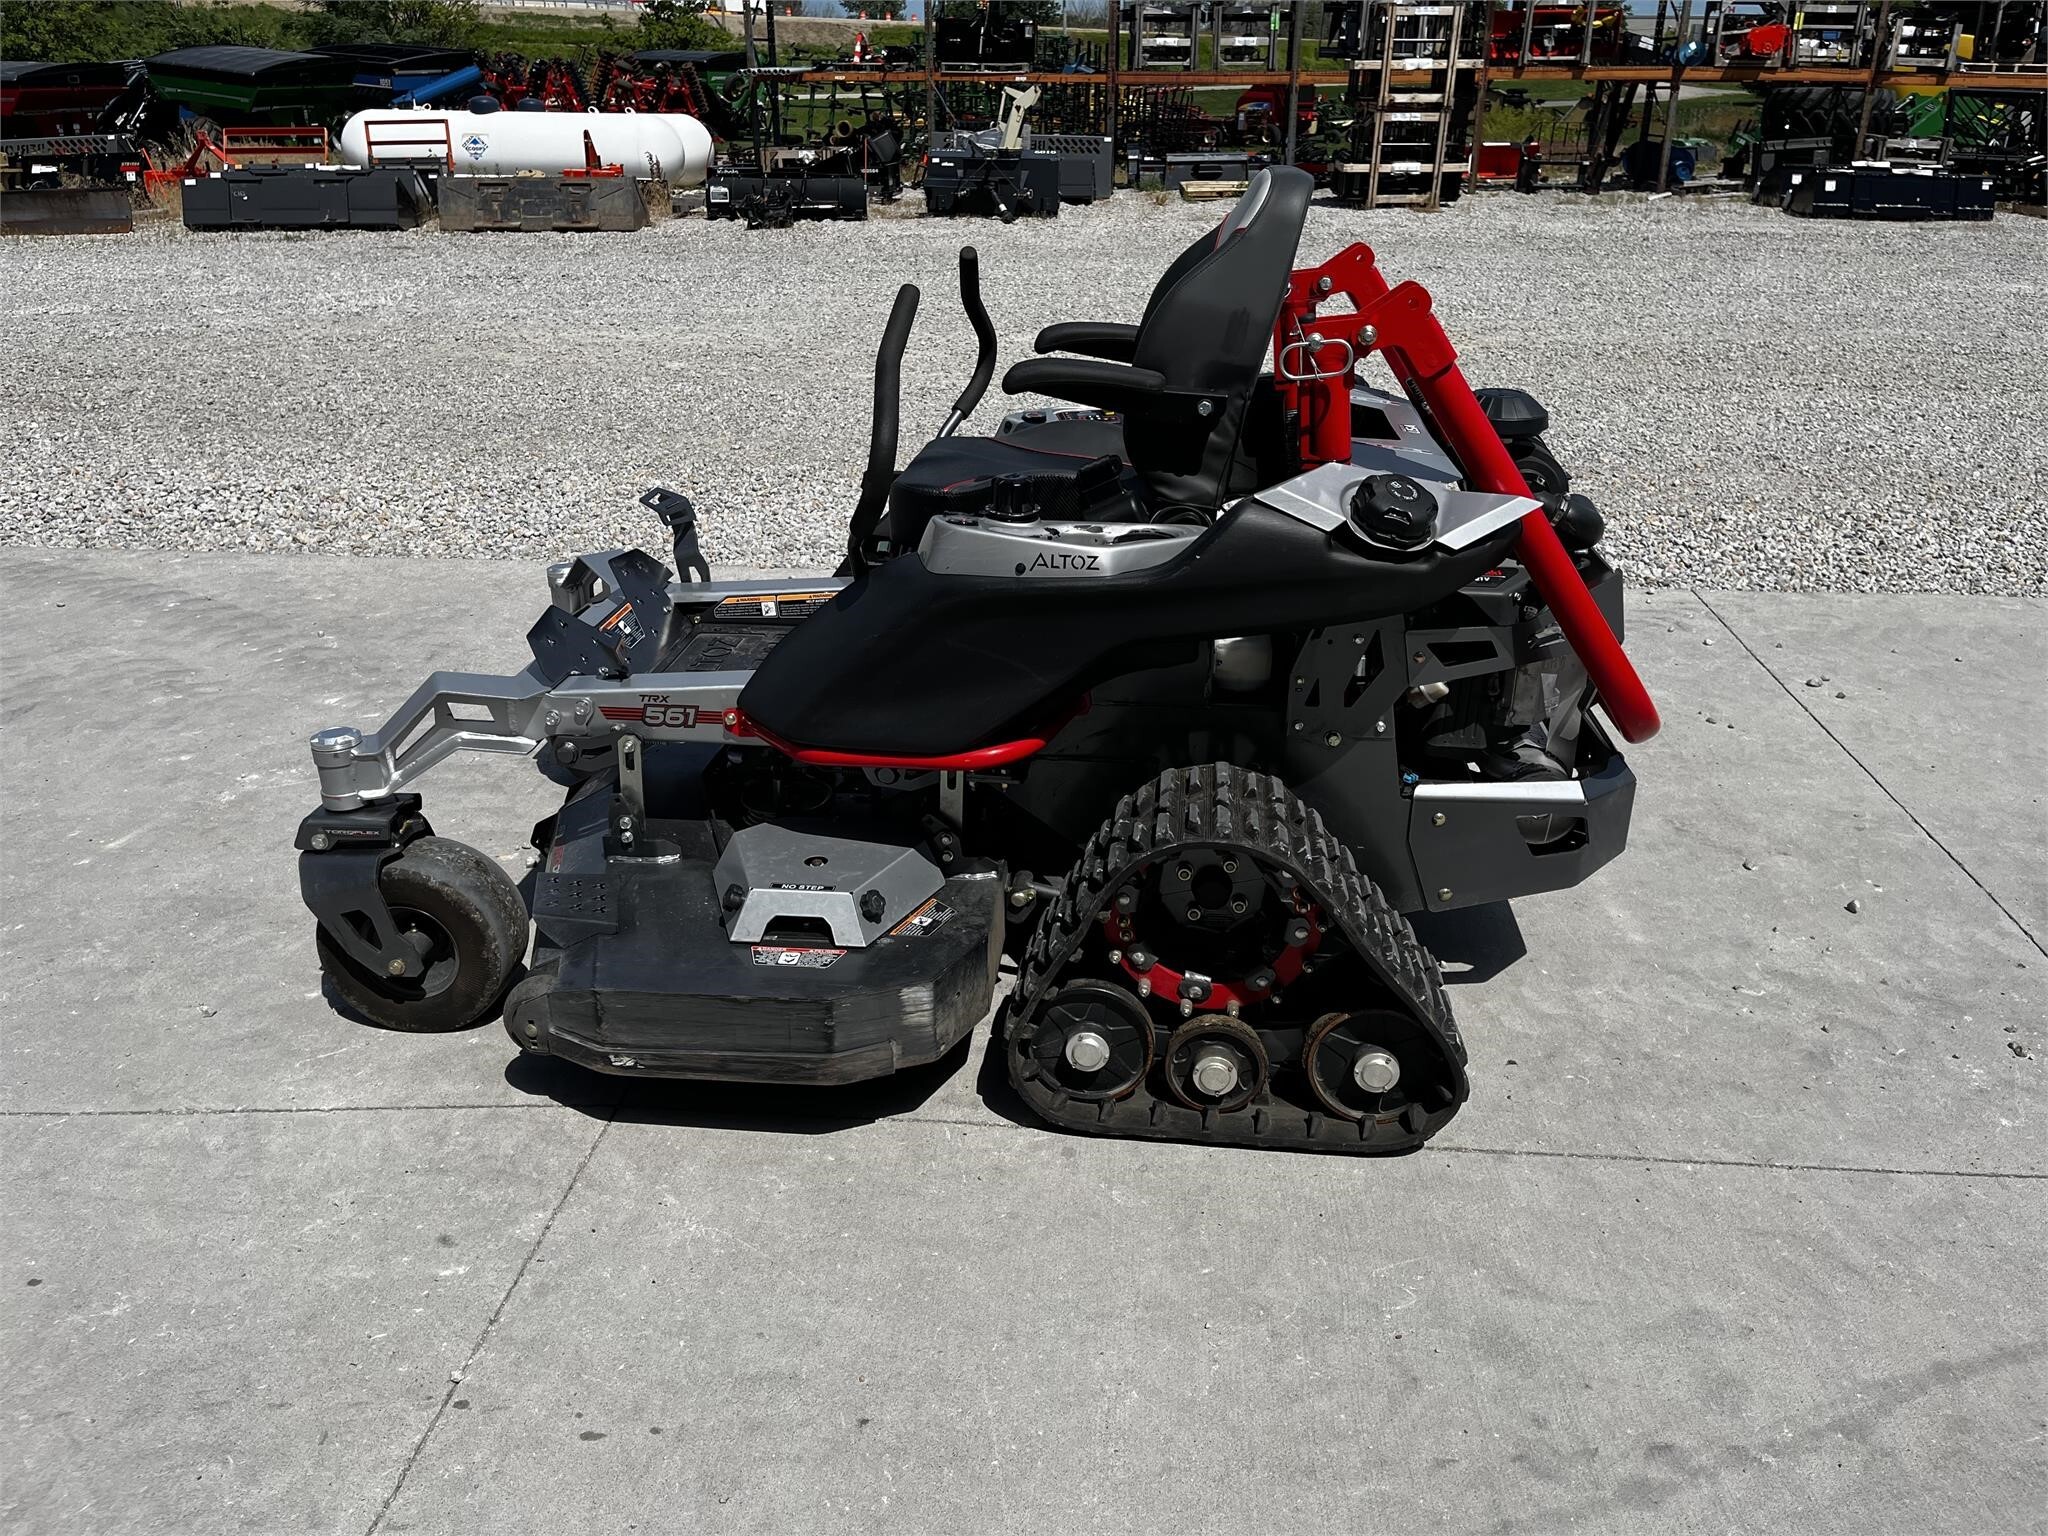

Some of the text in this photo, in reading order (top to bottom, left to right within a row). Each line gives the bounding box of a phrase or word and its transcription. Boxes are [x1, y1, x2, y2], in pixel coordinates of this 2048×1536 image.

[1029, 552, 1100, 572] ALTOZ
[639, 694, 670, 704] TRX
[643, 704, 700, 728] 561
